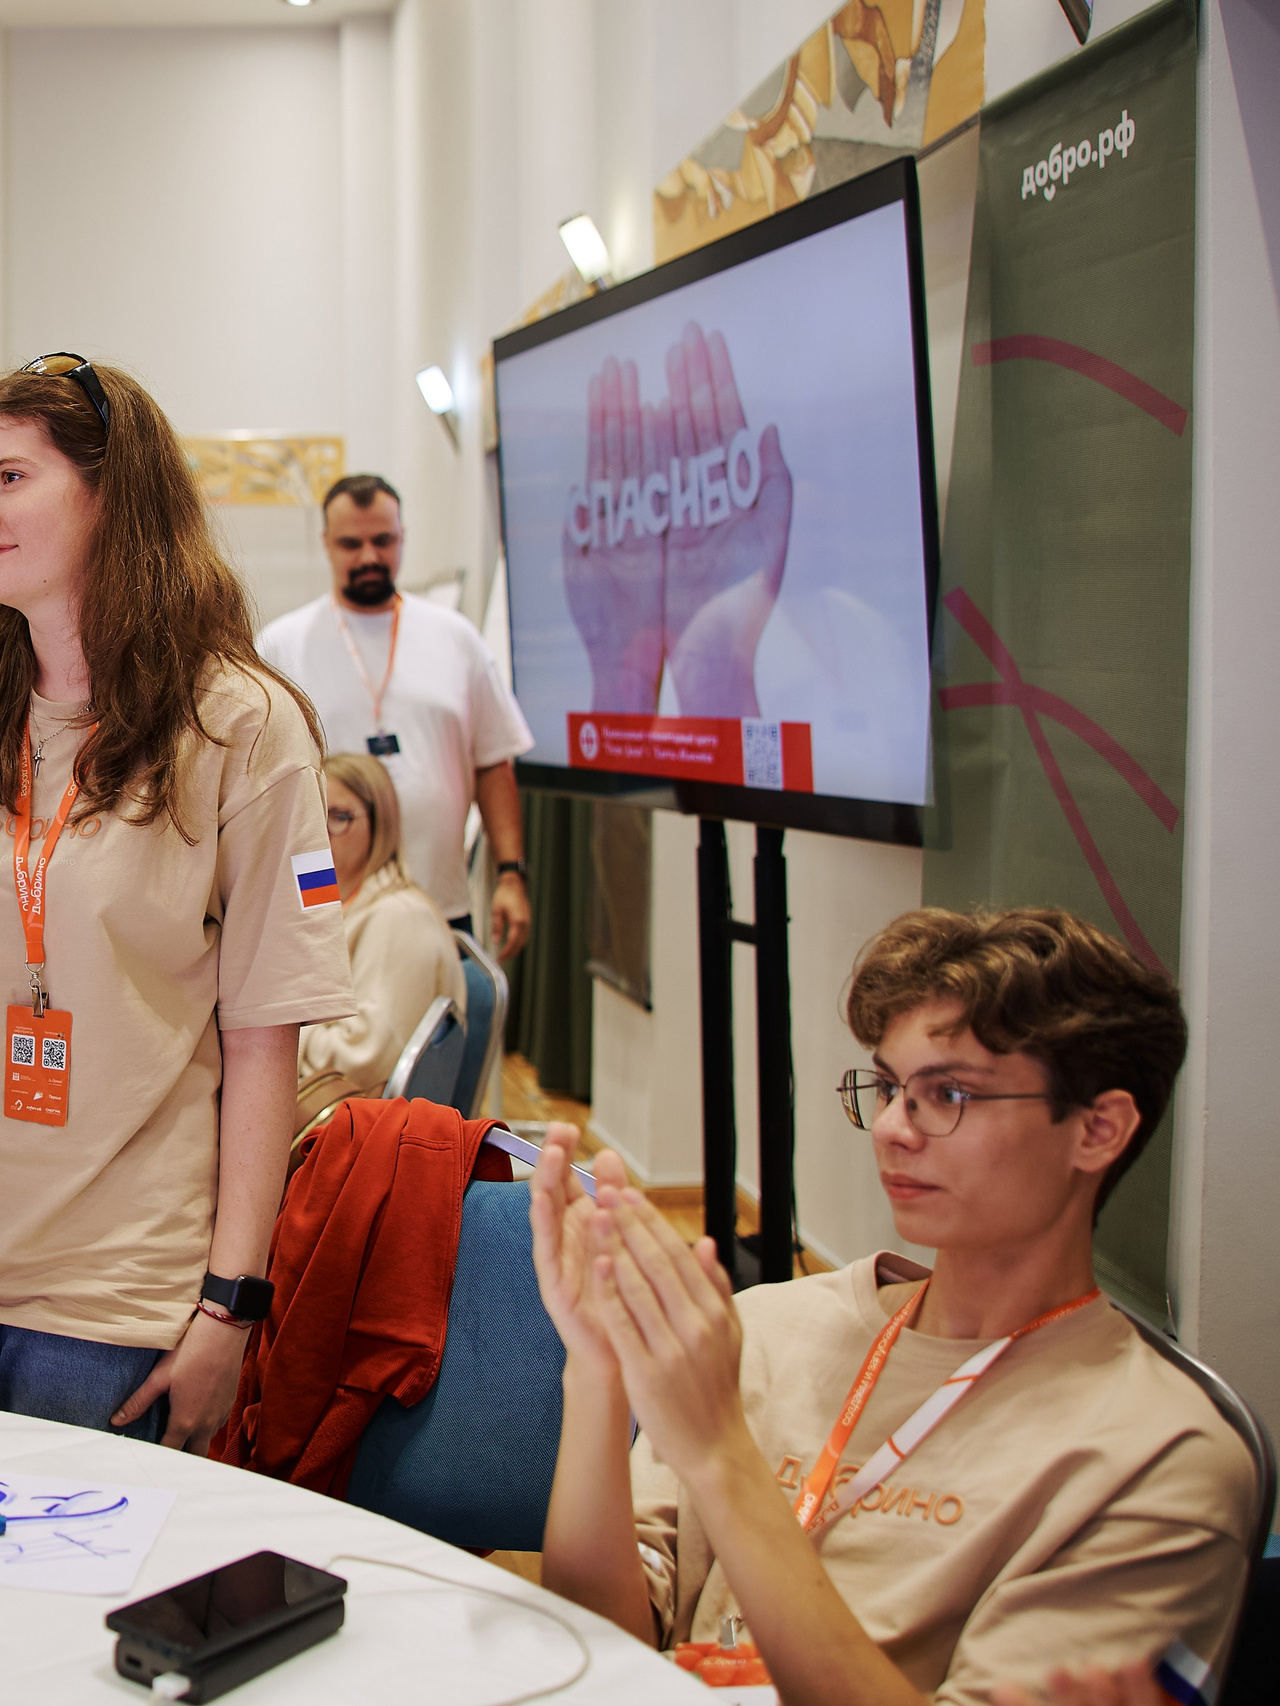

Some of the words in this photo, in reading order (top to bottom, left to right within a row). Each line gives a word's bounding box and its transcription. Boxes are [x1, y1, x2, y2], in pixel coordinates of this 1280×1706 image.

[1021, 108, 1136, 201] добро.рф
[568, 428, 761, 549] СПАСИБО
[30, 857, 46, 915] добрино
